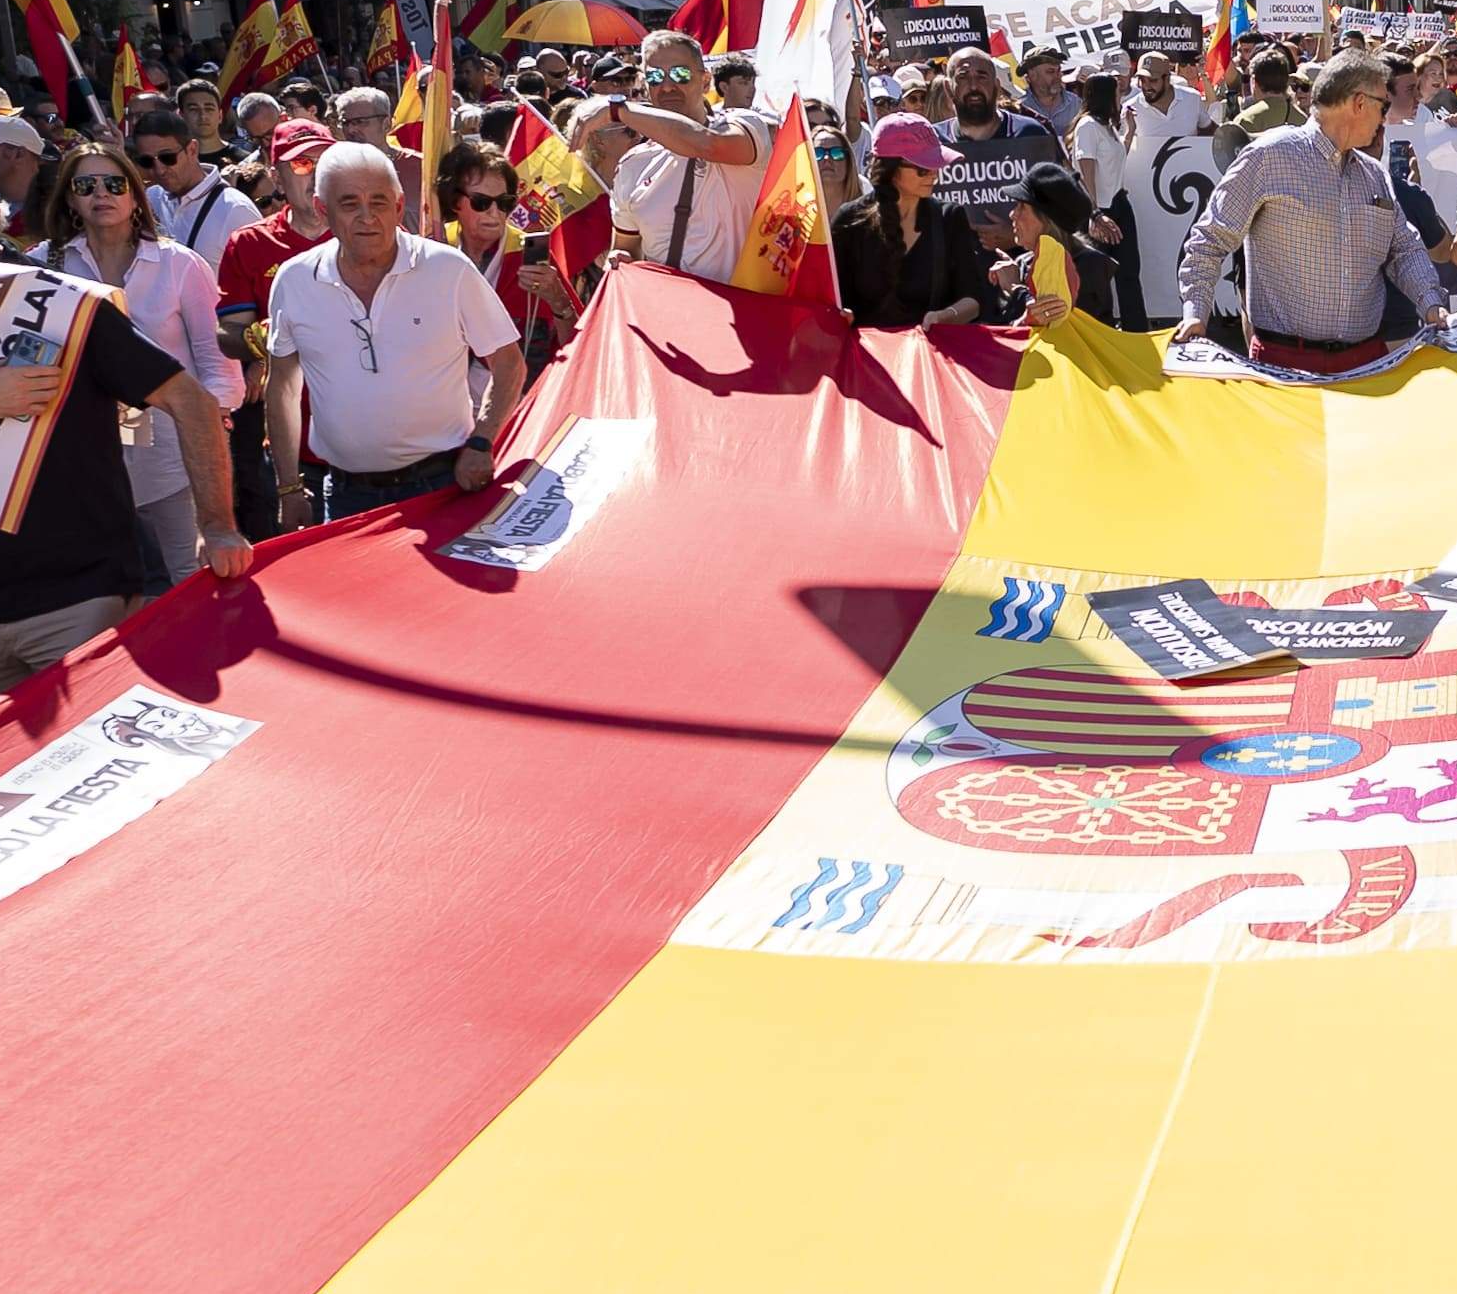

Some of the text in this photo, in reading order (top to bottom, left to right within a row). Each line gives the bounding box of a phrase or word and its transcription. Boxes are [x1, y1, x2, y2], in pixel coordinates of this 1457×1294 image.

[903, 13, 970, 35] ¡DISOLUCIÓN
[986, 11, 1033, 37] SE
[1138, 24, 1193, 40] ¡DISOLUCIÓN
[911, 34, 936, 47] MAFIA
[1142, 41, 1162, 51] MAFIA
[938, 155, 1028, 186] ISOLUCIÓN
[11, 288, 57, 333] LA
[505, 499, 562, 538] FIESTA
[21, 803, 73, 839] LA
[48, 757, 151, 818] FIESTA
